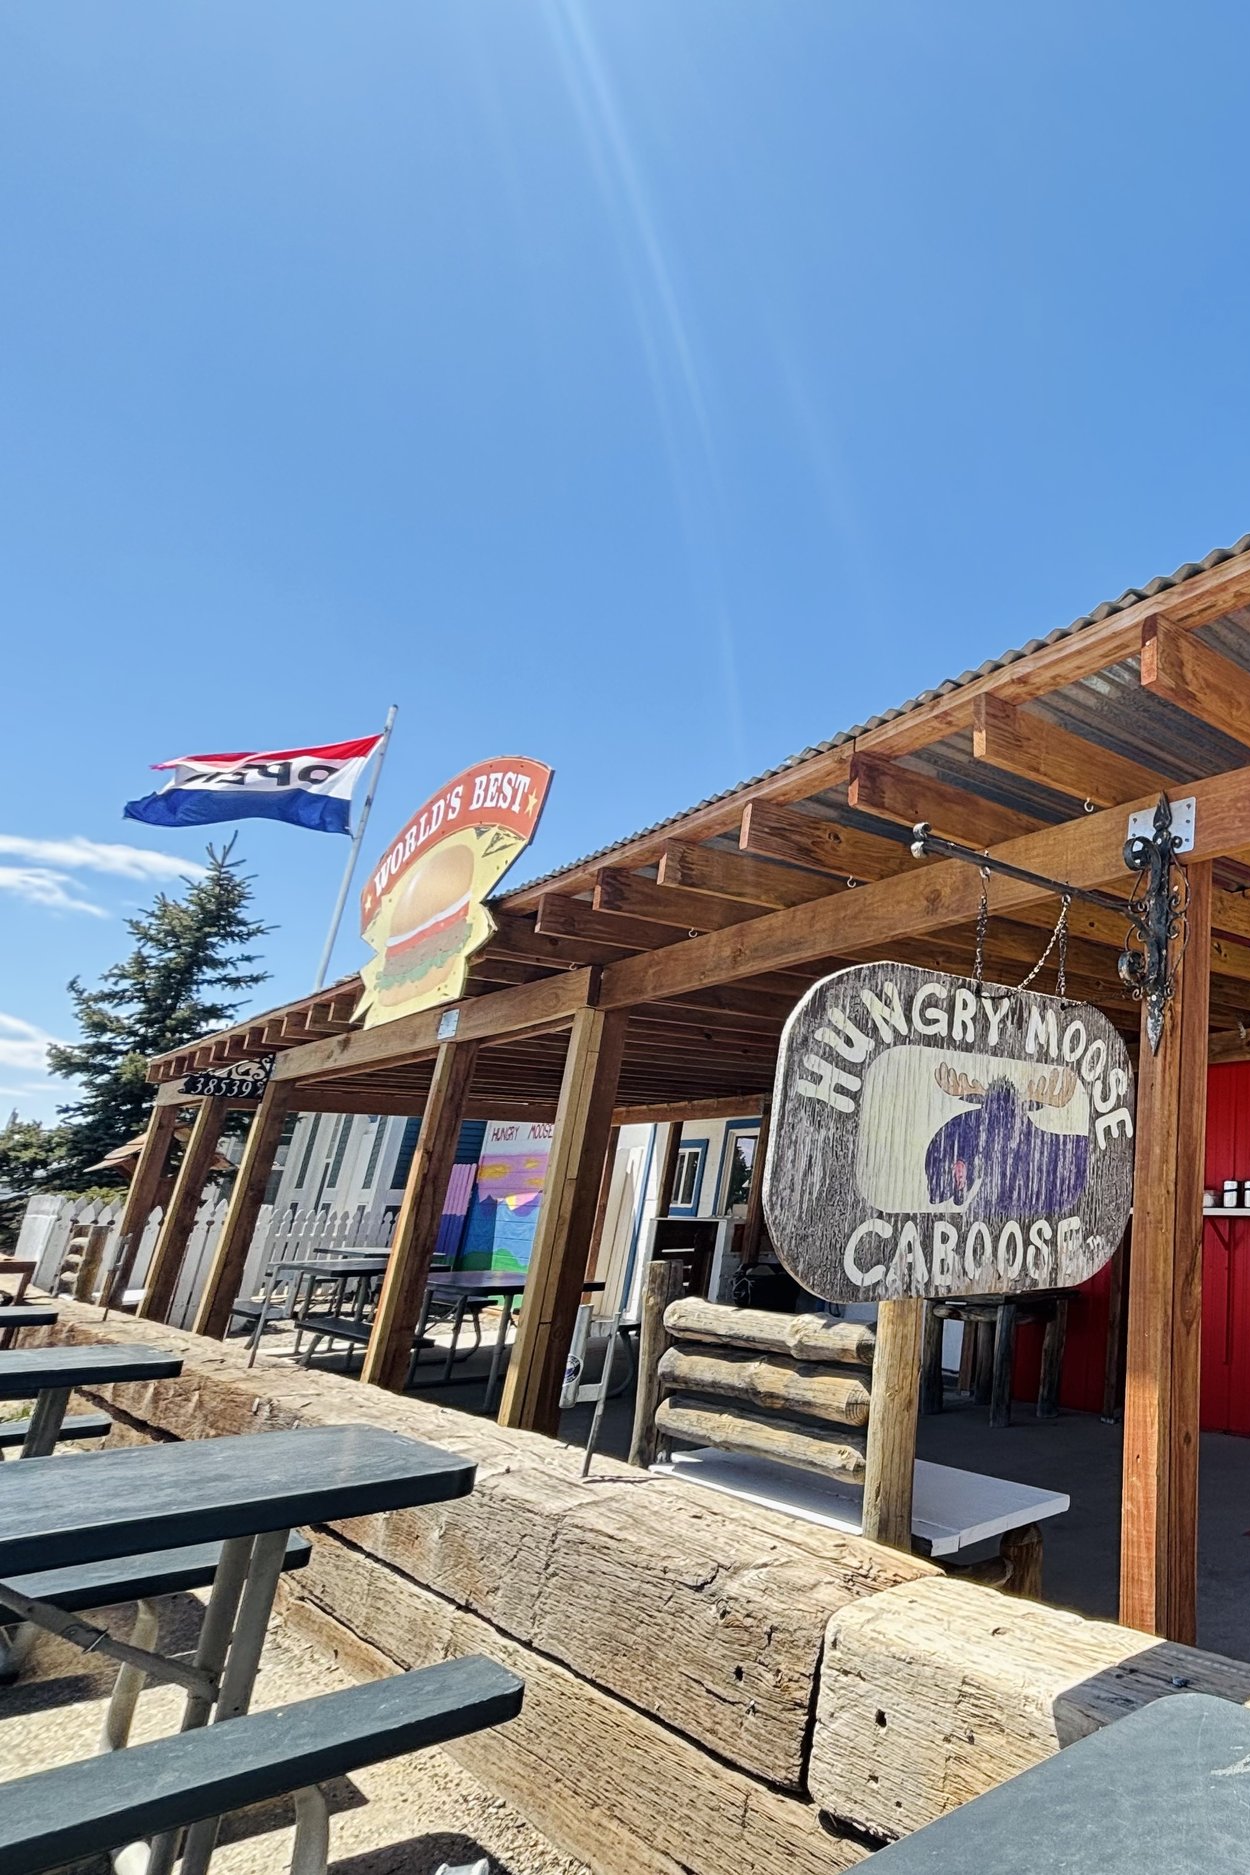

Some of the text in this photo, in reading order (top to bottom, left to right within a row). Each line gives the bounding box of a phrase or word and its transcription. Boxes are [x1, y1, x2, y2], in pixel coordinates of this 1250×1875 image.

[374, 772, 531, 896] WORLD'S BEST
[190, 1077, 252, 1097] 38539
[798, 981, 1133, 1149] HUNGRY MOOSE
[491, 1123, 554, 1141] HUNGRY MOOSE
[843, 1216, 1082, 1288] CABOOSE
